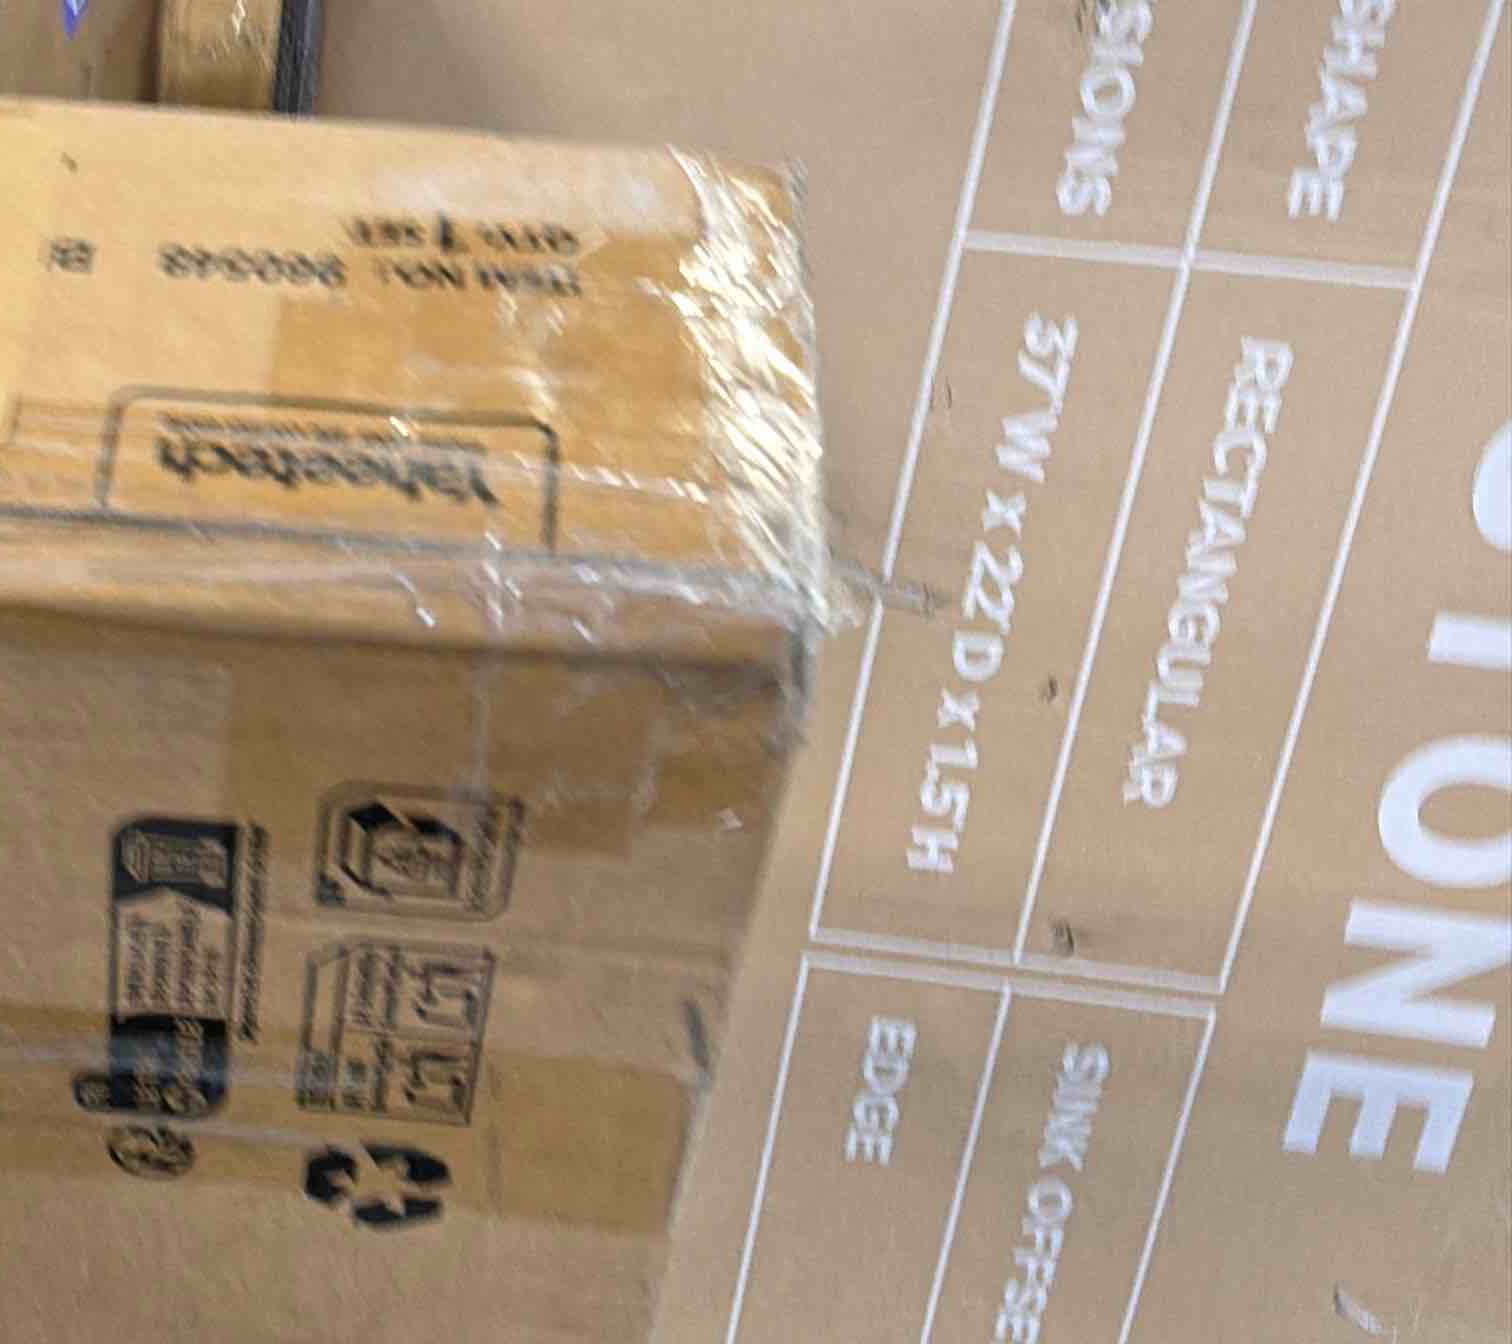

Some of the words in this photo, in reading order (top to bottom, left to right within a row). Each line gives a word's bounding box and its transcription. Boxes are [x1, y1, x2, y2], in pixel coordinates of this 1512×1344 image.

[1121, 335, 1294, 809] RECTANGULAR
[844, 1014, 916, 1168] EDGE
[1038, 1041, 1110, 1173] SINK
